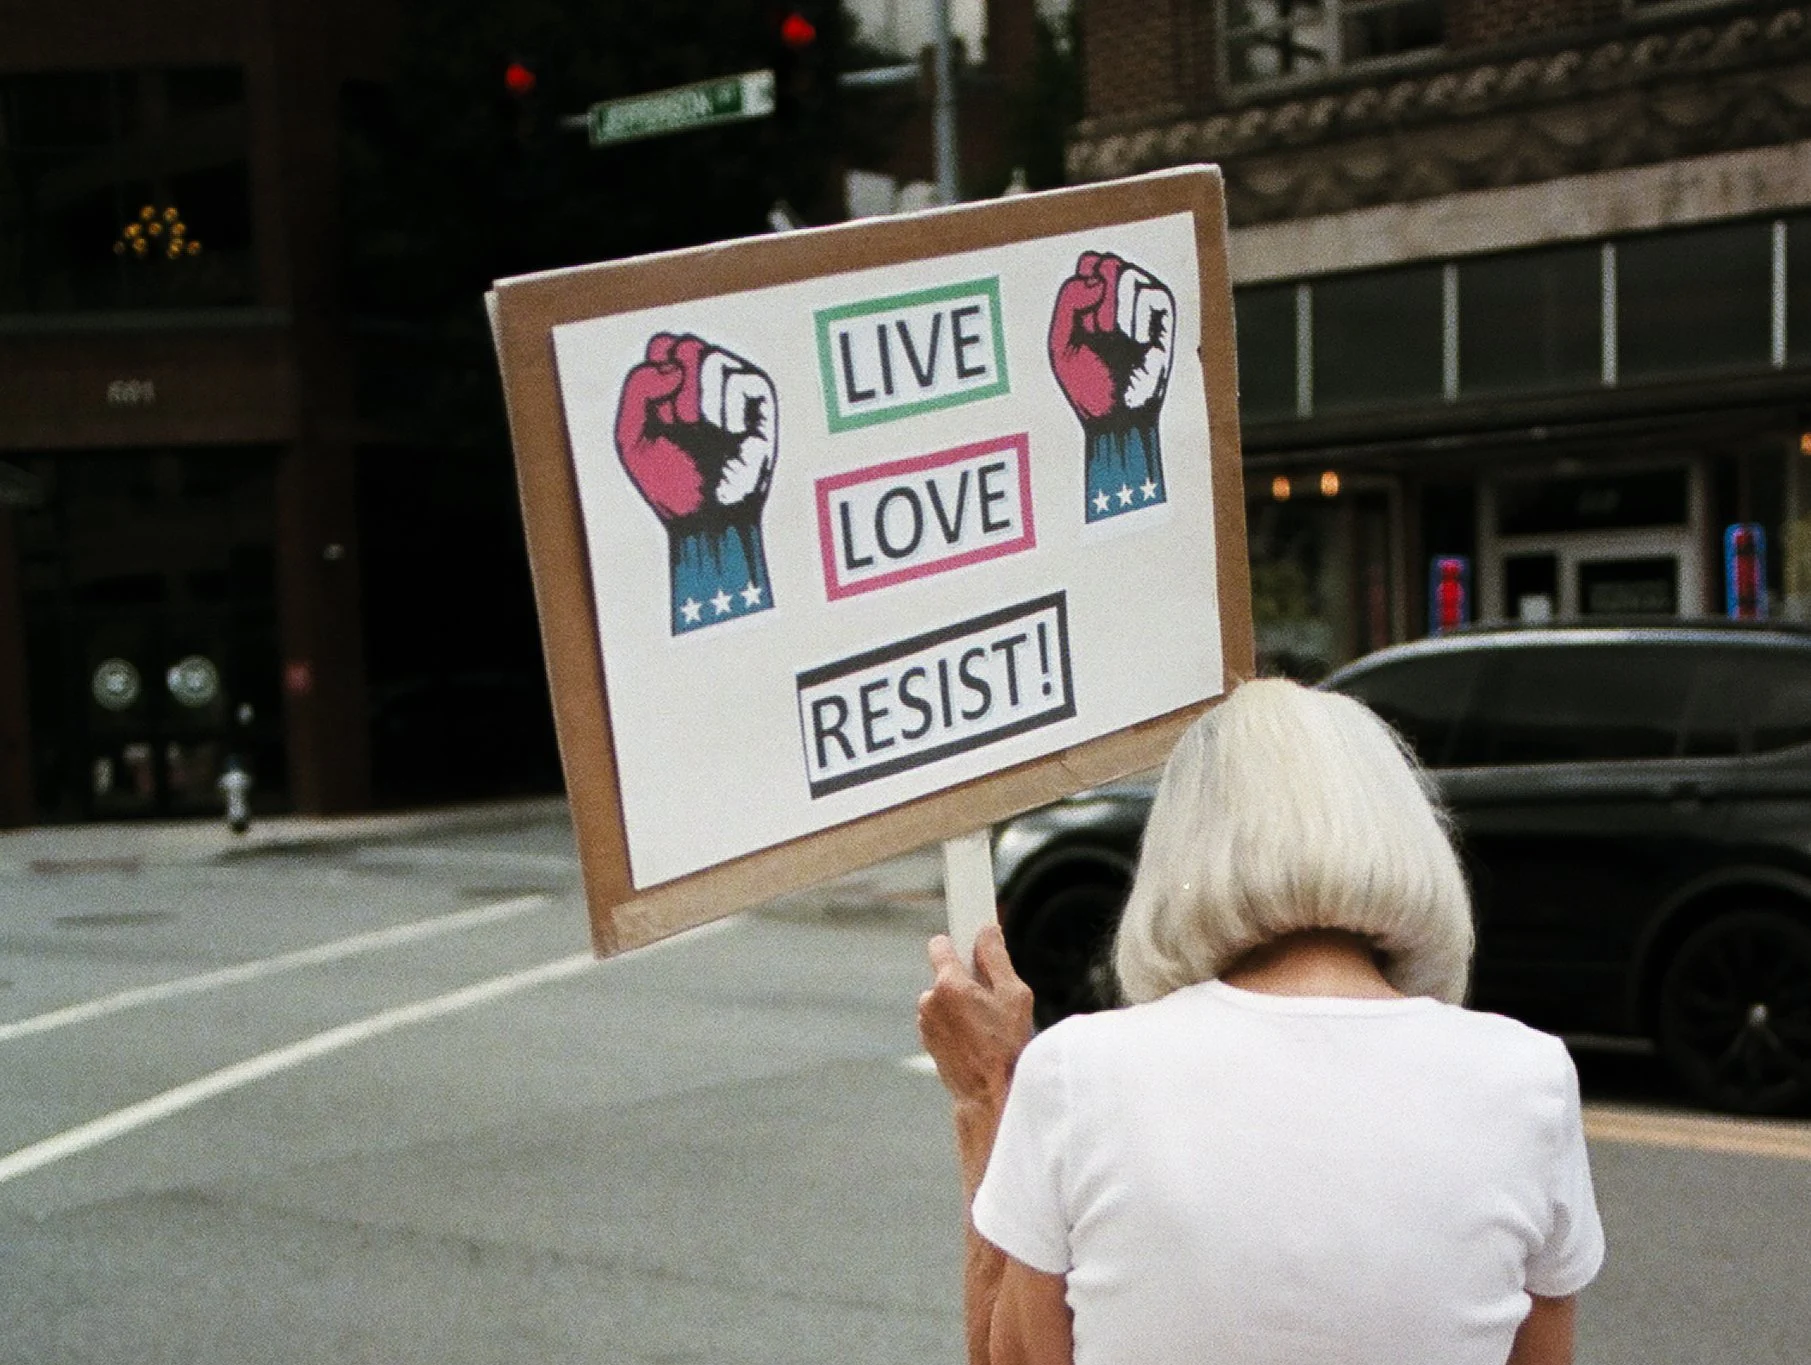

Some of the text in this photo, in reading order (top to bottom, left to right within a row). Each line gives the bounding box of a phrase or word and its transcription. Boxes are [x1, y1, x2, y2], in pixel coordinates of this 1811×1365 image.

[839, 305, 986, 404] LIVE
[839, 461, 1011, 571] LOVE
[811, 621, 1051, 768] RESIST!
